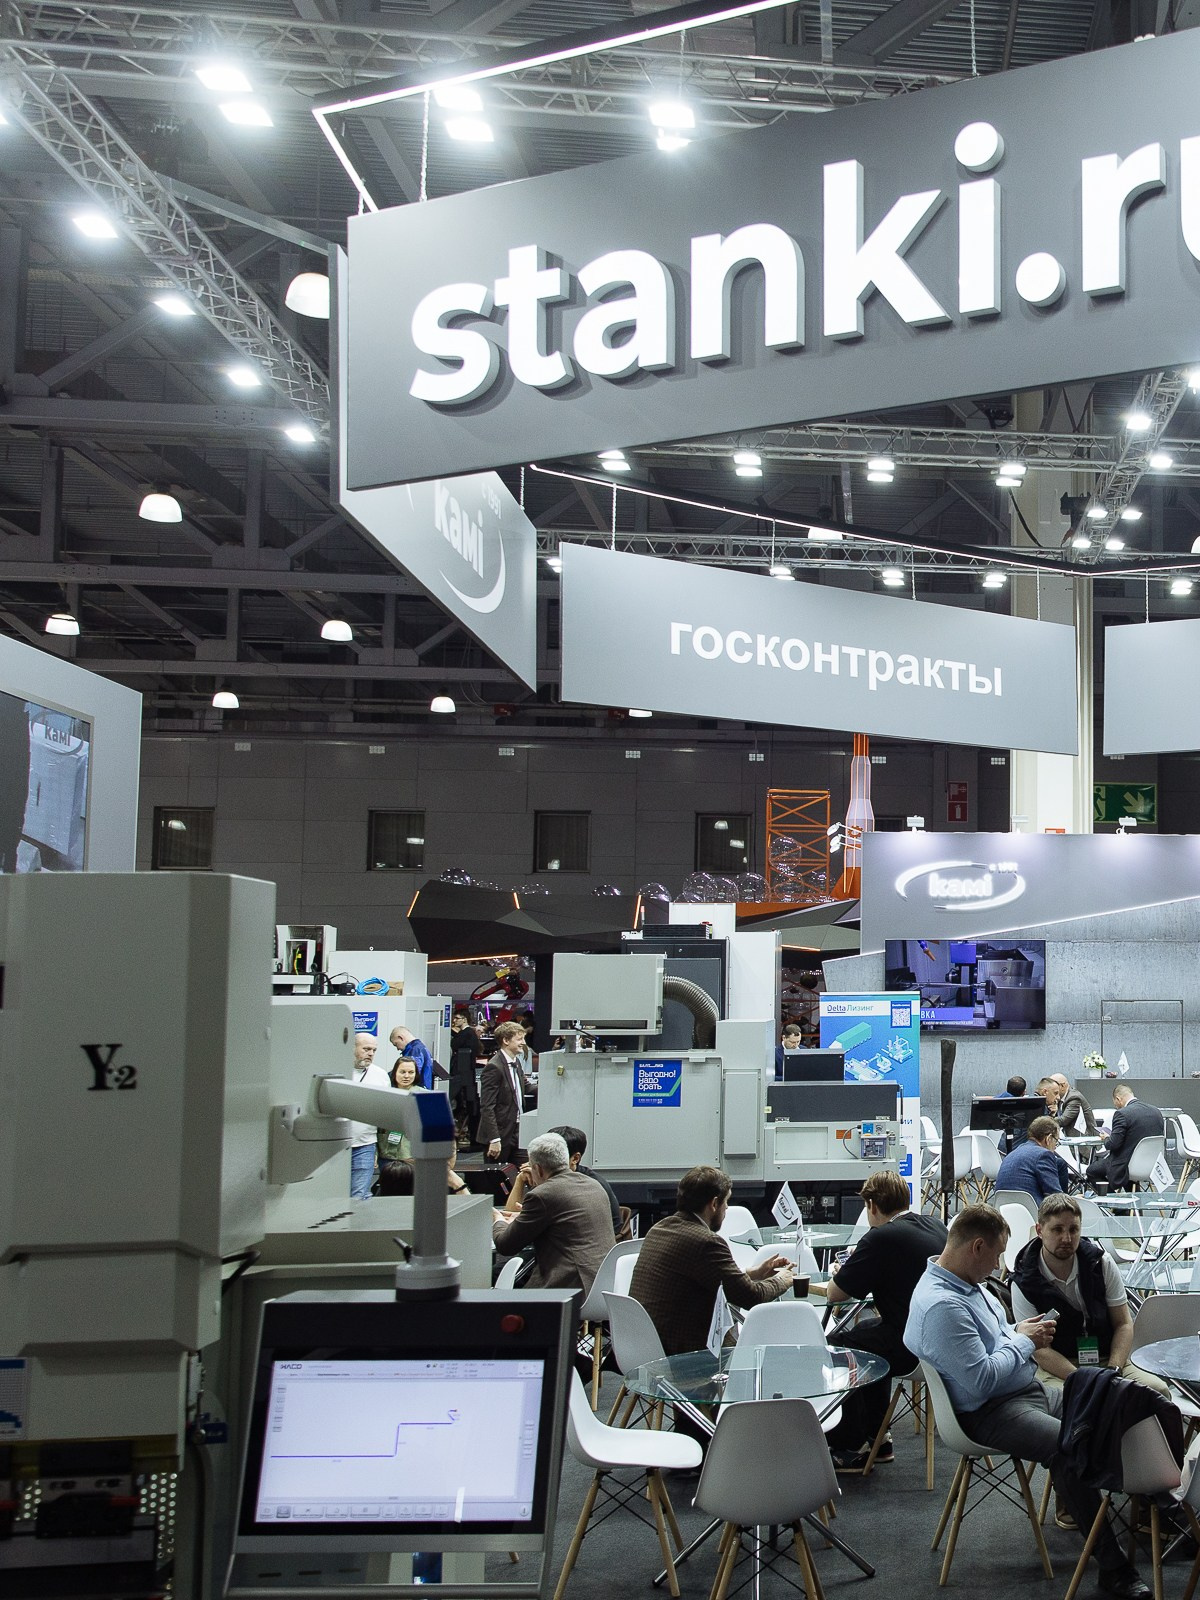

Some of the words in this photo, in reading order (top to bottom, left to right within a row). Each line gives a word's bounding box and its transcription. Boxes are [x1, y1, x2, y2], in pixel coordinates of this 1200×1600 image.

[669, 621, 1003, 697] госконтракты
[638, 1069, 676, 1078] Выгодно!
[638, 1083, 663, 1091] брать
